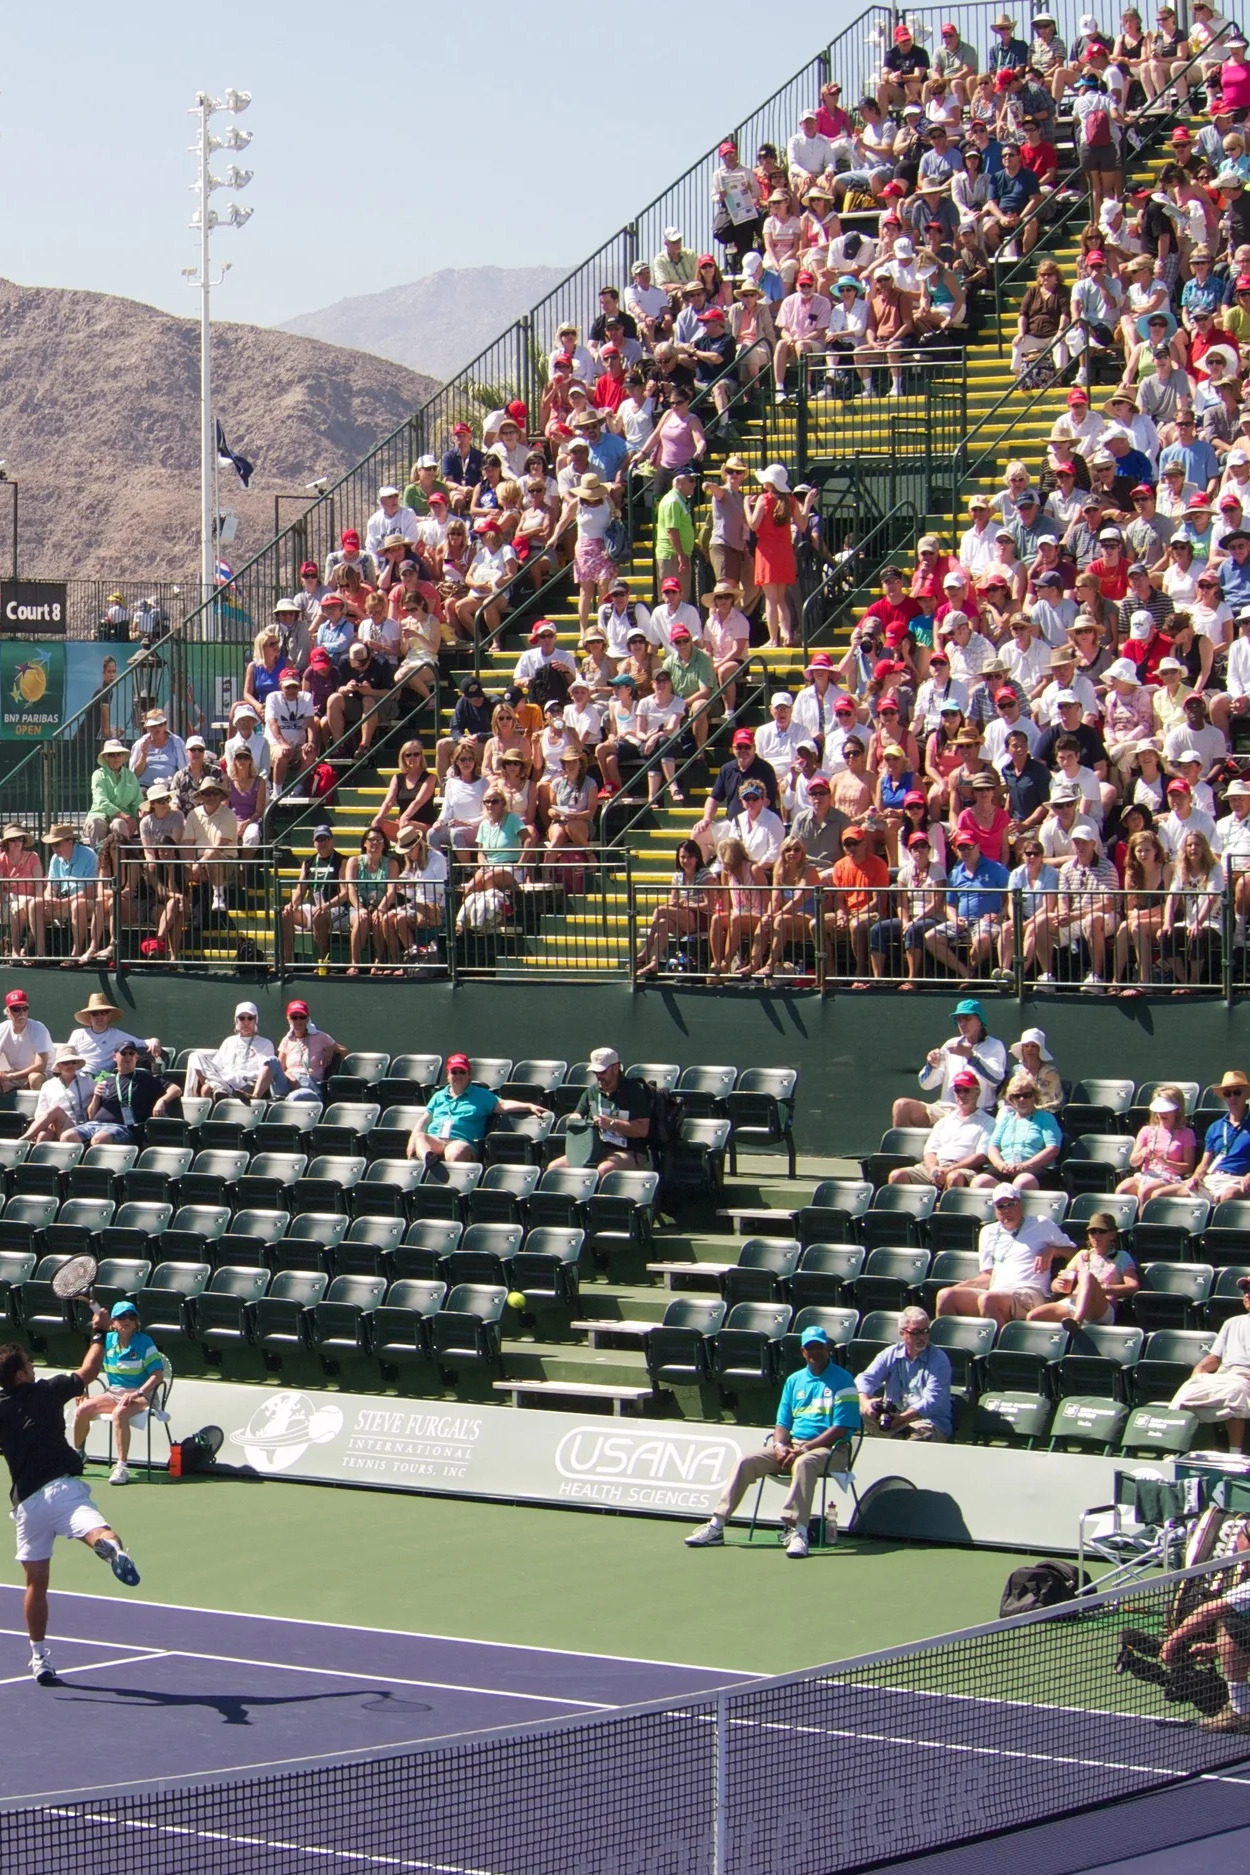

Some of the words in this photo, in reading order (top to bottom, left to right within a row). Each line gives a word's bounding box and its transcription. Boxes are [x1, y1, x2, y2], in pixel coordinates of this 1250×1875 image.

[6, 601, 50, 621] Court
[52, 603, 61, 621] 8
[4, 713, 20, 723] BNP
[21, 713, 59, 723] PARIBAS
[15, 725, 42, 736] OPEN
[354, 1409, 405, 1433] STEVE
[405, 1414, 483, 1440] FURGAL'S
[348, 1438, 472, 1459] INTERNATIONAL
[570, 1435, 727, 1482] USANA
[342, 1457, 387, 1471] TENNIS
[443, 1467, 467, 1478] INC
[559, 1481, 622, 1500] HEALTH
[627, 1488, 710, 1508] SCIENCES
